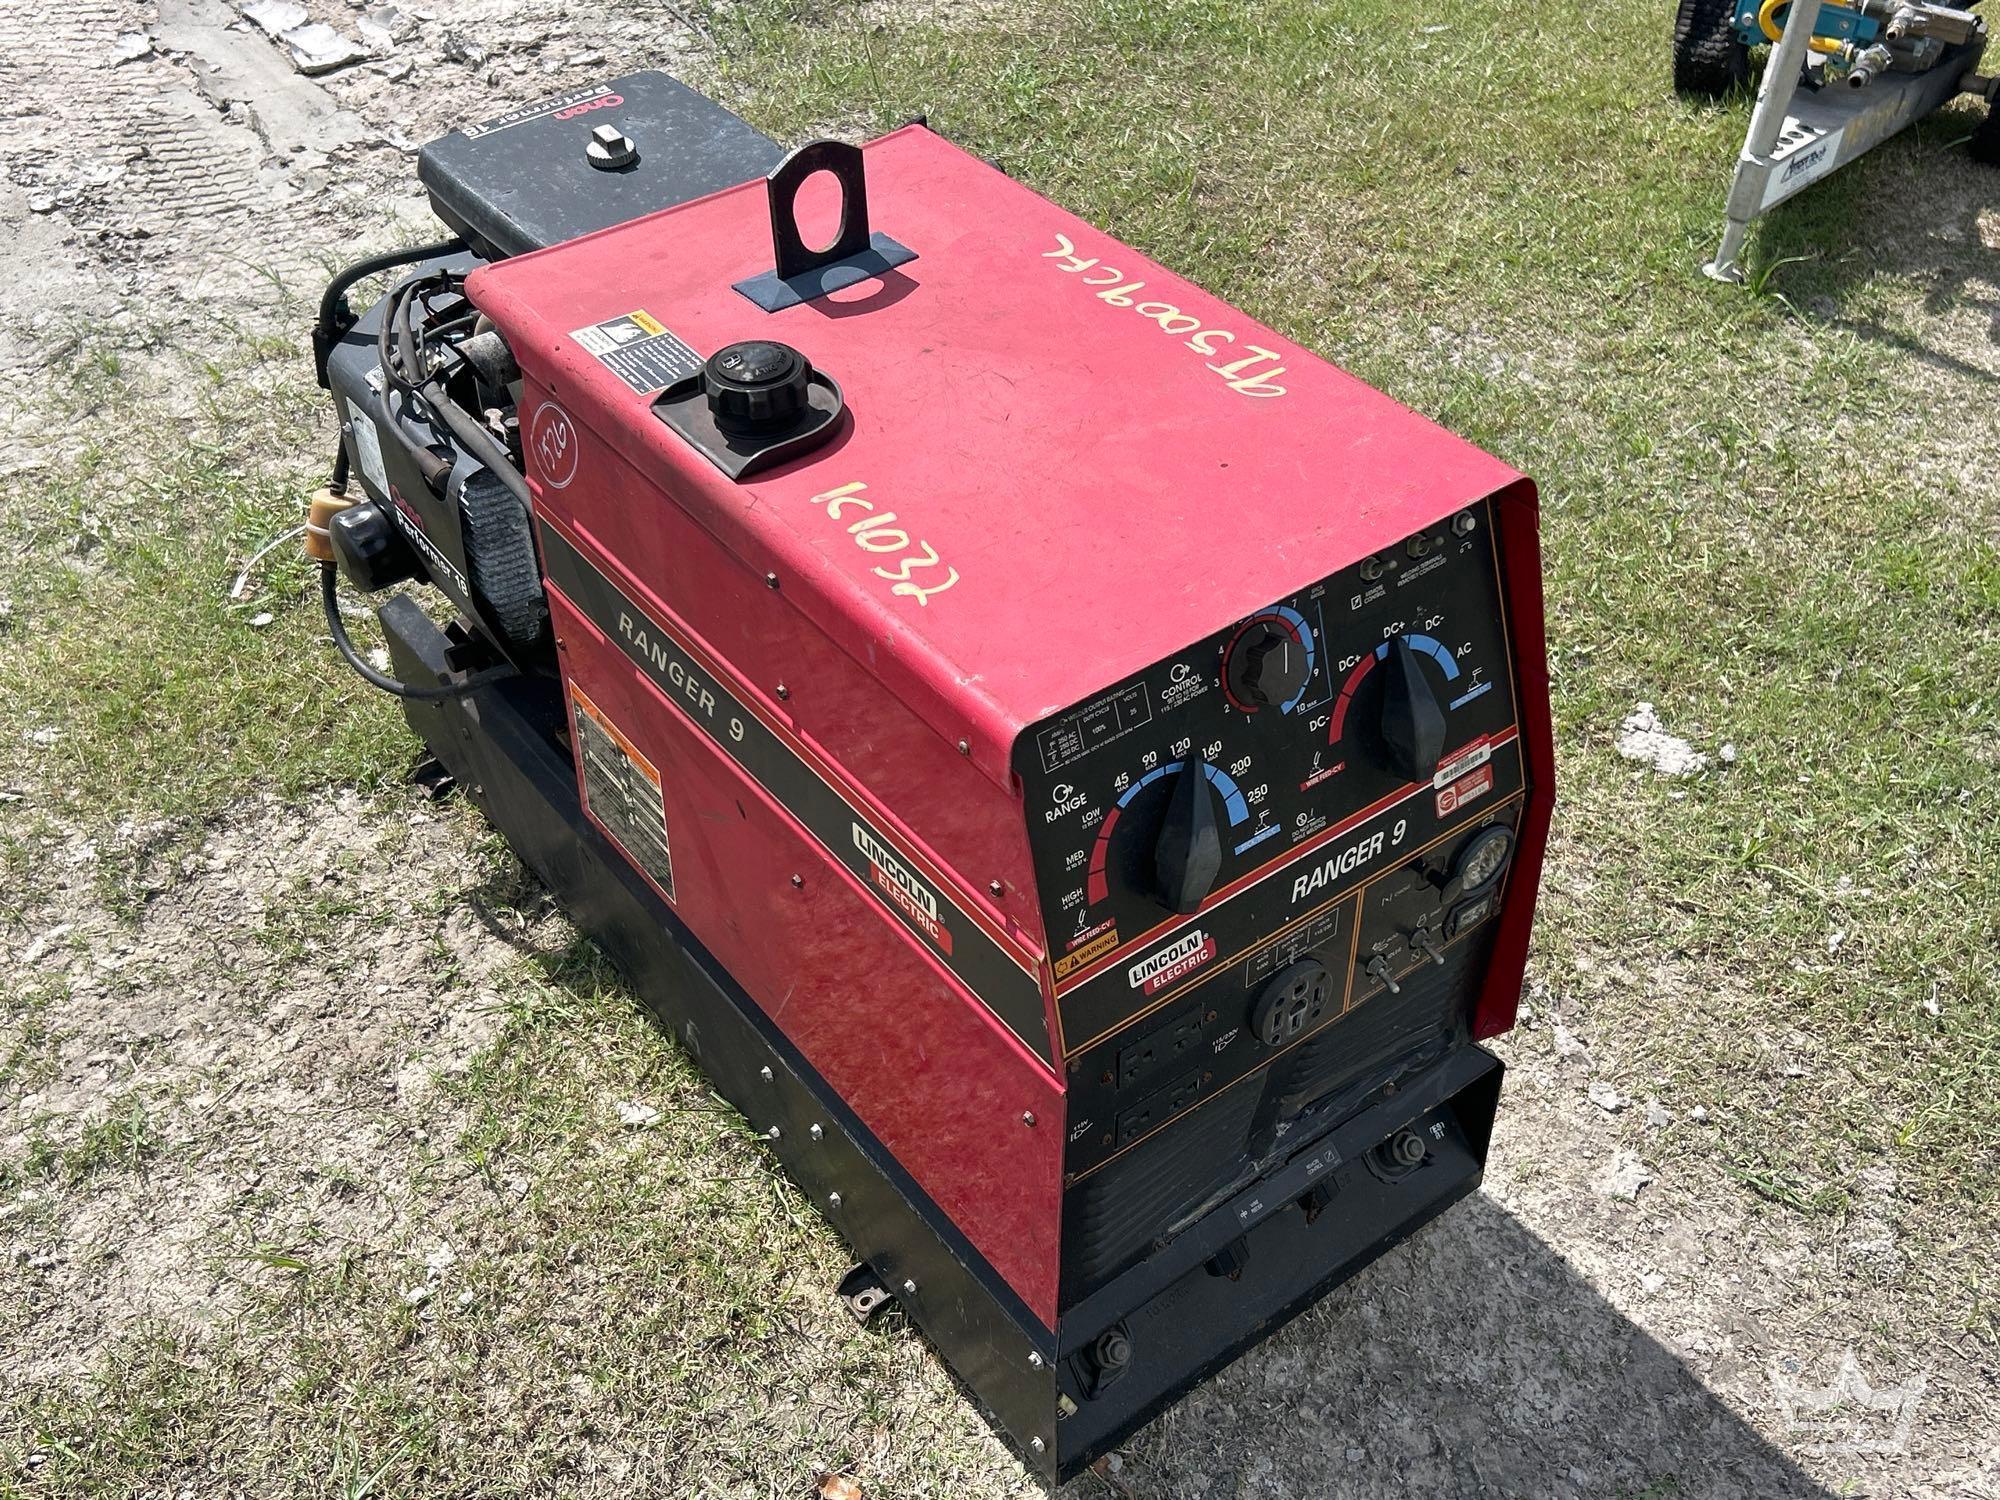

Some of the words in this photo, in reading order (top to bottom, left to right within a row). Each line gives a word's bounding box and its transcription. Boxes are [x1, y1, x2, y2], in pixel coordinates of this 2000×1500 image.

[552, 94, 625, 120] Onan
[809, 481, 960, 607] K1032
[395, 510, 451, 578] Performer
[455, 574, 469, 598] 18
[1383, 620, 1406, 639] DC+
[1425, 614, 1445, 631] DC-
[1456, 642, 1472, 659] AC
[1338, 654, 1361, 672] DC+
[618, 612, 716, 718] RANGER
[728, 718, 745, 742] 9
[1313, 668, 1319, 677] 9
[1161, 673, 1203, 700] CONTROL
[1214, 678, 1220, 687] 3
[1223, 704, 1230, 713] 2
[1296, 702, 1306, 713] 10
[1309, 715, 1331, 732] DC-
[1169, 737, 1191, 756] 120
[1201, 740, 1223, 759] 160
[1141, 750, 1158, 767] 90
[1144, 762, 1157, 771] MAX
[1230, 755, 1252, 775] 200
[1114, 771, 1130, 789] 45
[1236, 769, 1249, 778] MAX
[1117, 784, 1130, 793] MAX
[1247, 783, 1269, 803] 250
[1045, 793, 1088, 824] RANGE
[1252, 796, 1266, 805] MAX
[1081, 807, 1101, 824] LOW
[1065, 849, 1085, 866] MED
[1291, 831, 1384, 904] RANGER
[1391, 819, 1407, 846] 9
[858, 830, 931, 914] LINCOLN
[878, 871, 939, 939] ELECTRIC
[1061, 887, 1084, 905] HIGH
[1071, 935, 1086, 948] WIRE
[1078, 935, 1116, 960] WARNING
[1133, 935, 1199, 983] LINCOLN
[1153, 949, 1209, 989] ELECTRIC
